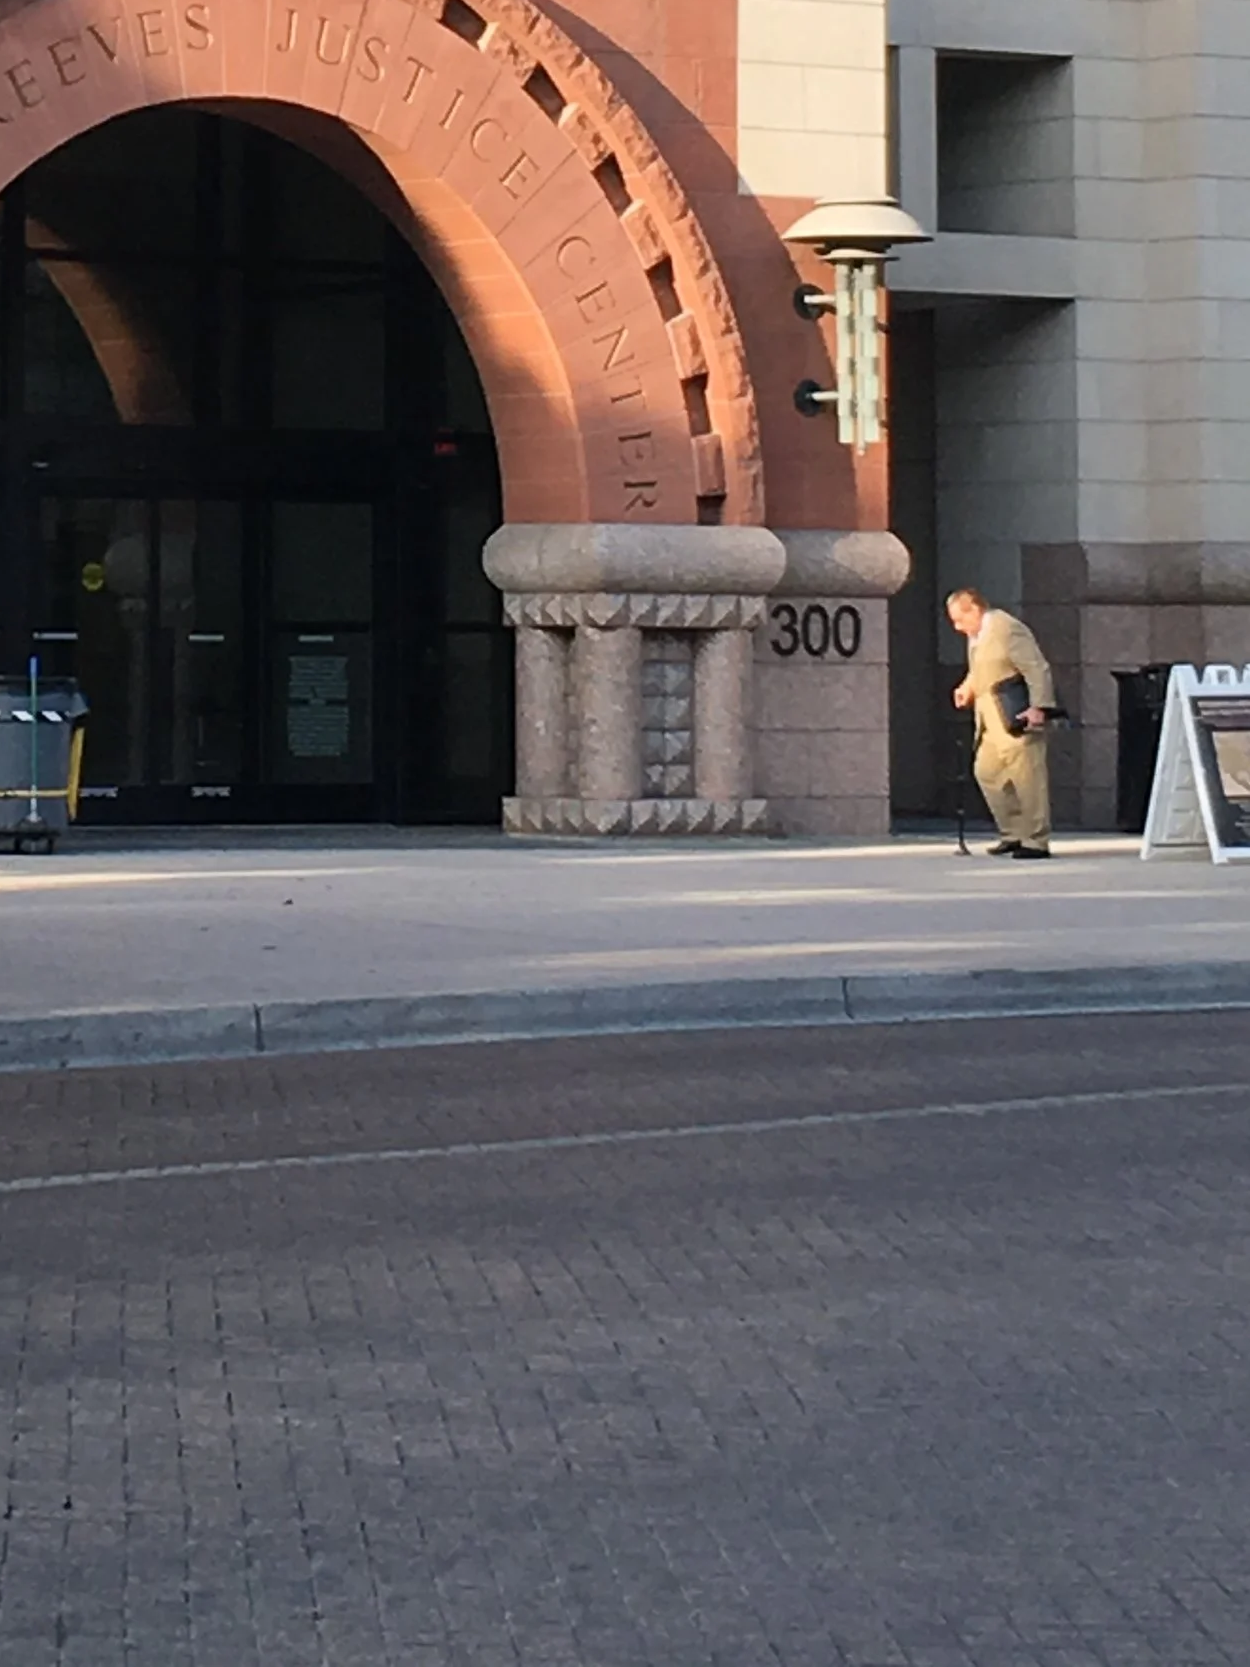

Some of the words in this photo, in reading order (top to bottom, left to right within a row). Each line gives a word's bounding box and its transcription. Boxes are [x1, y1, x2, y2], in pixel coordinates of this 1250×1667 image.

[275, 7, 541, 201] JUSTICE
[555, 234, 659, 514] CENTER
[770, 603, 863, 659] 300
